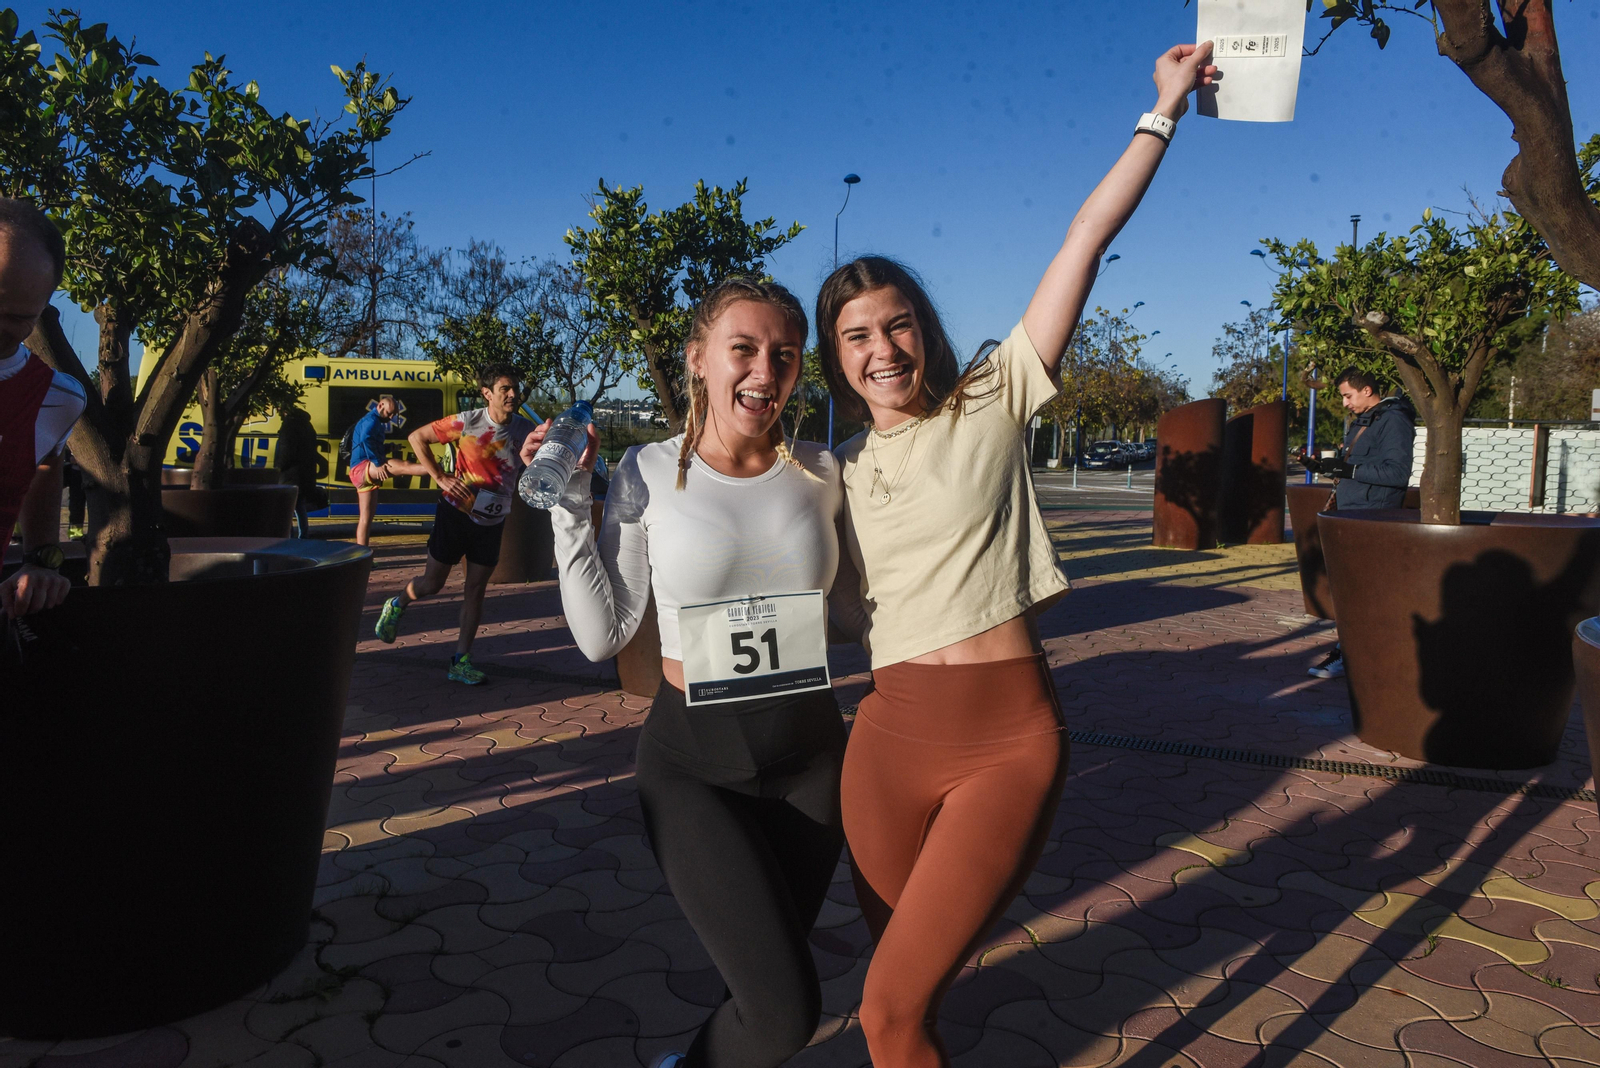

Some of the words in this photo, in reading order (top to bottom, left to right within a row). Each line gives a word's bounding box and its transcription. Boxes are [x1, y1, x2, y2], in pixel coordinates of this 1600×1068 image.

[333, 368, 443, 382] AMBULANCIA
[484, 502, 503, 515] 49
[731, 628, 779, 674] 51
